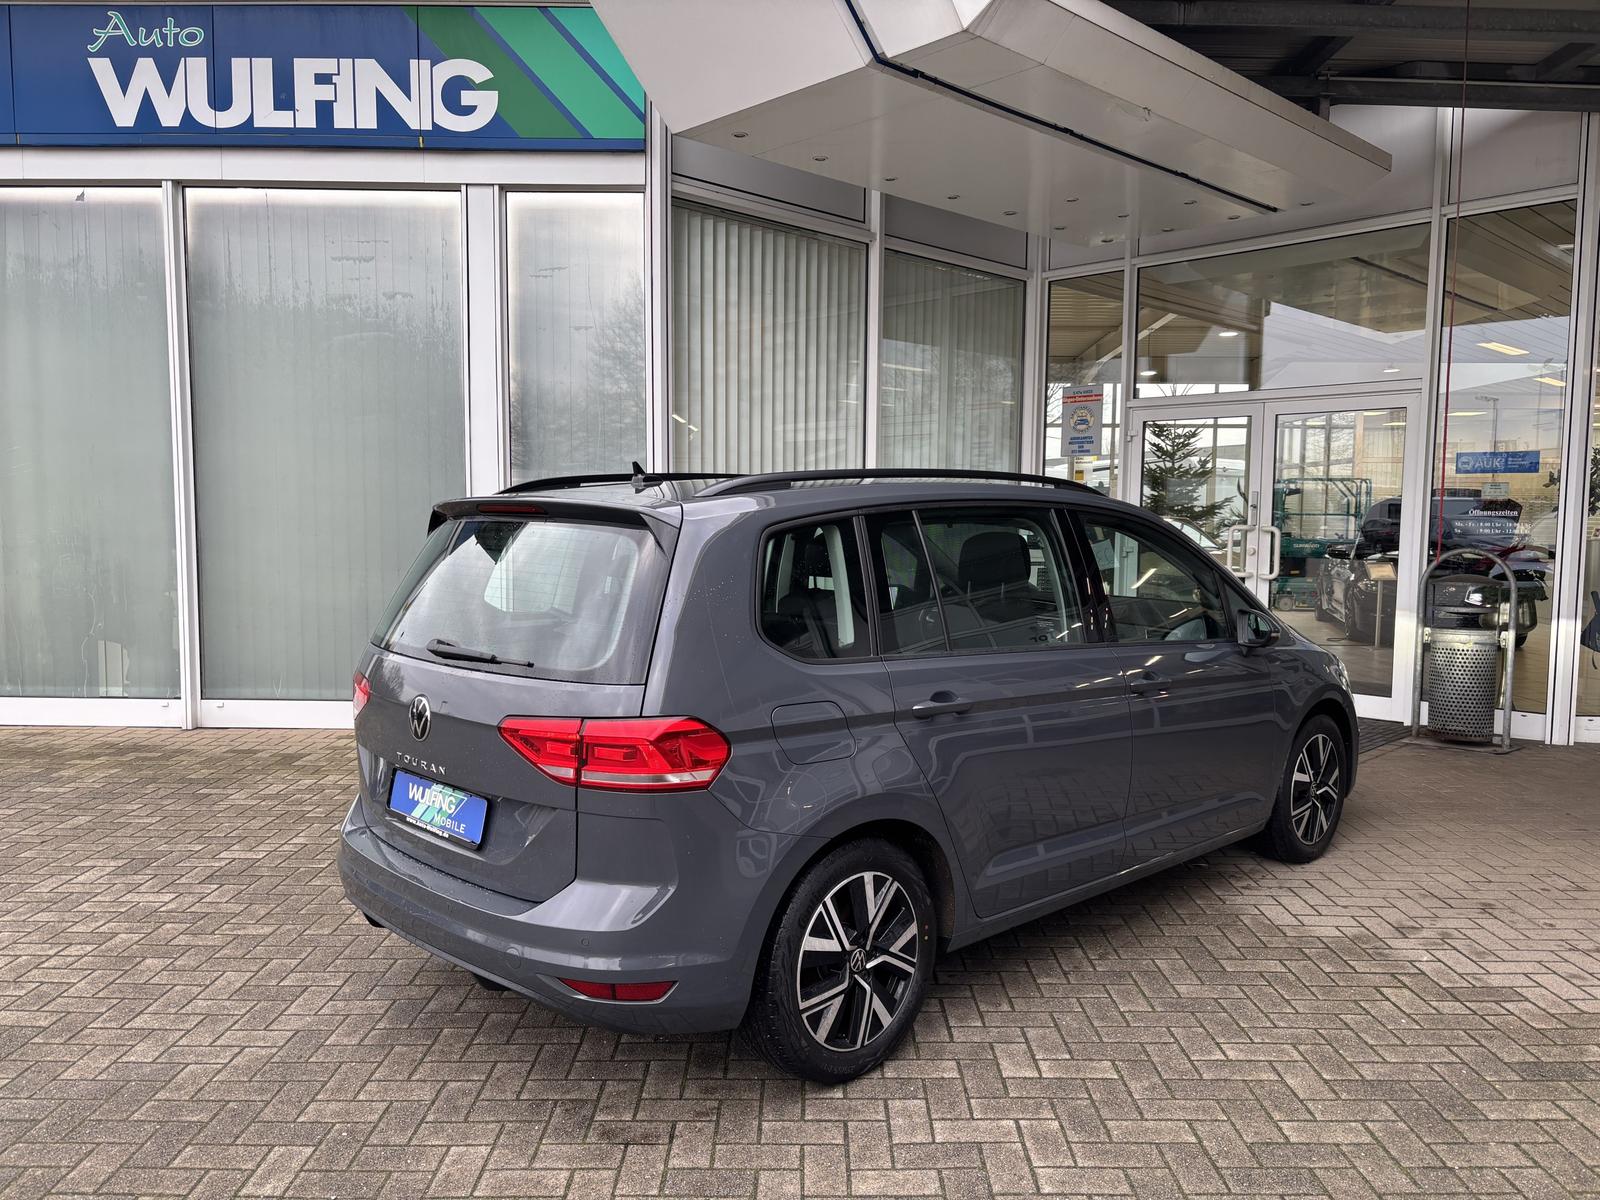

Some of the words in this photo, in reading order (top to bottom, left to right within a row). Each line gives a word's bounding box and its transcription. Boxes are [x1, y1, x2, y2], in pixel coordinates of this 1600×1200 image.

[87, 11, 205, 53] Auto
[87, 57, 499, 132] WULFING
[1469, 508, 1518, 517] Öffnungszeiten
[396, 751, 447, 775] TOURAN
[408, 782, 456, 813] WULFING
[433, 811, 466, 834] MOBILE
